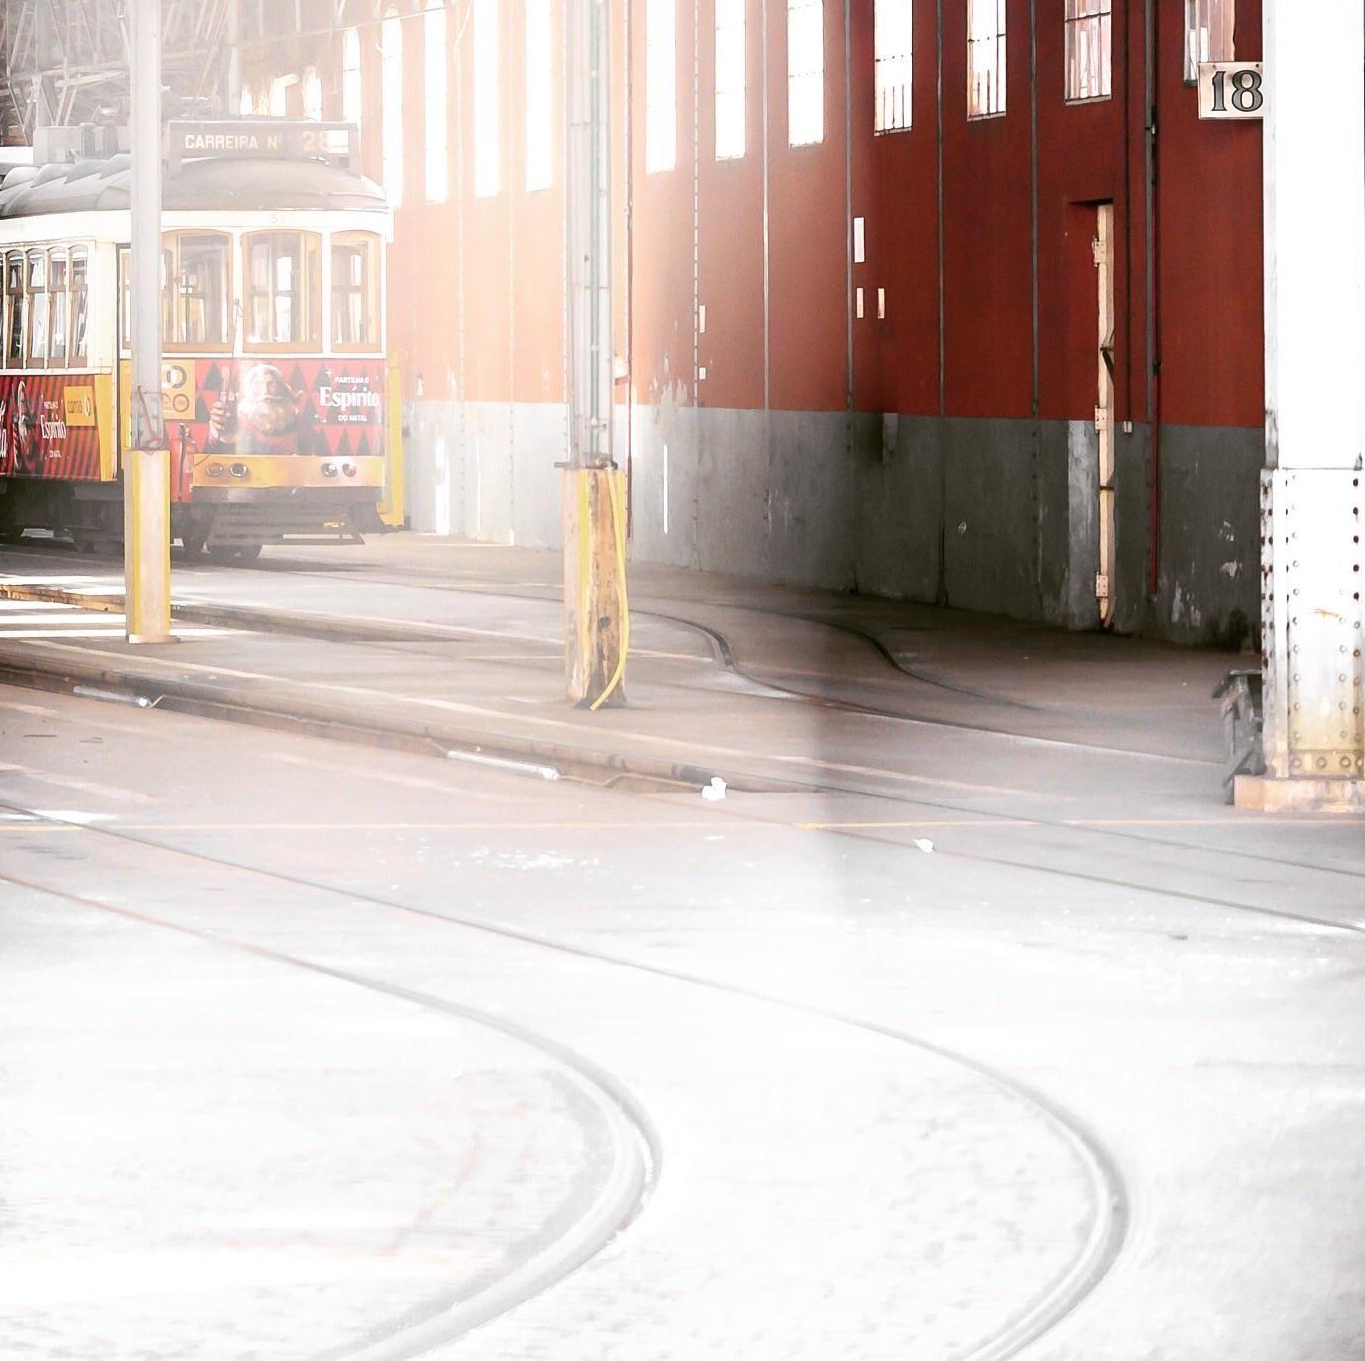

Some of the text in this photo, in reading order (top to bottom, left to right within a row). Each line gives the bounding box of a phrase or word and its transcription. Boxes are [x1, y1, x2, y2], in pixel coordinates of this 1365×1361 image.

[1211, 70, 1264, 112] 18
[185, 135, 259, 150] CARREIRA
[319, 385, 380, 412] Espírito
